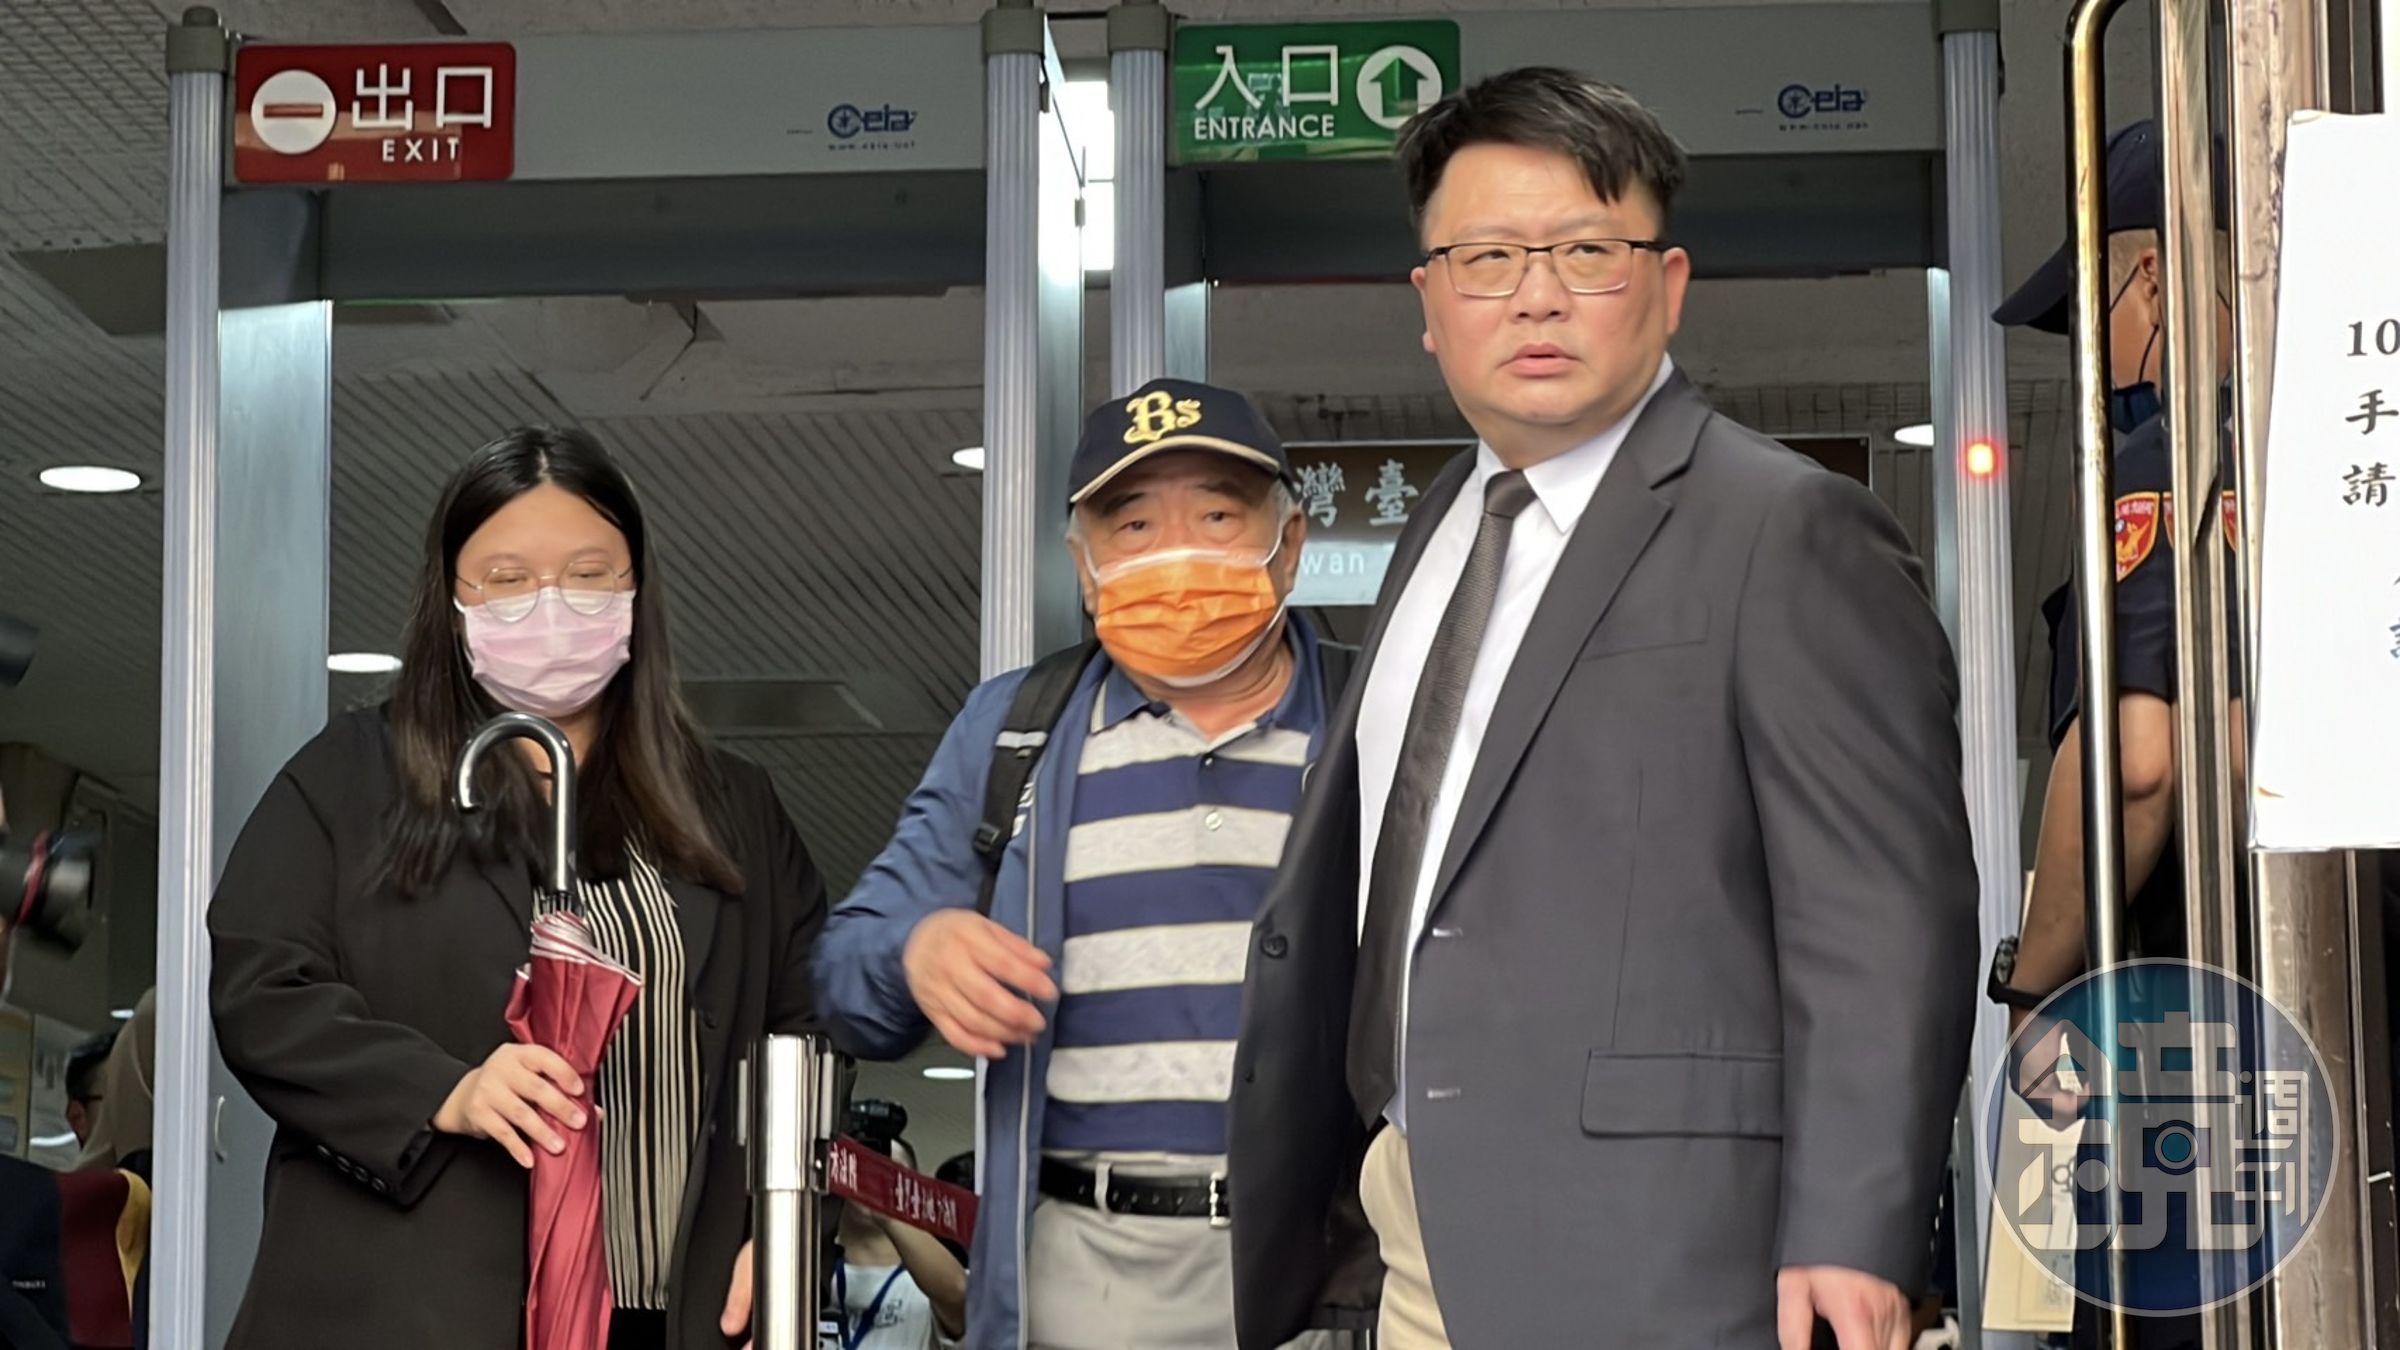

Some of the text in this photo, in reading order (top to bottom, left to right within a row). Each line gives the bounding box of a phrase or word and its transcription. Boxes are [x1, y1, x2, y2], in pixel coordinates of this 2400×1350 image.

[352, 64, 493, 131] 出口
[1194, 45, 1339, 110] 入口
[382, 137, 460, 163] EXIT
[1193, 114, 1335, 140] ENTRANCE
[1123, 390, 1202, 444] Bs
[2342, 461, 2396, 507] 請
